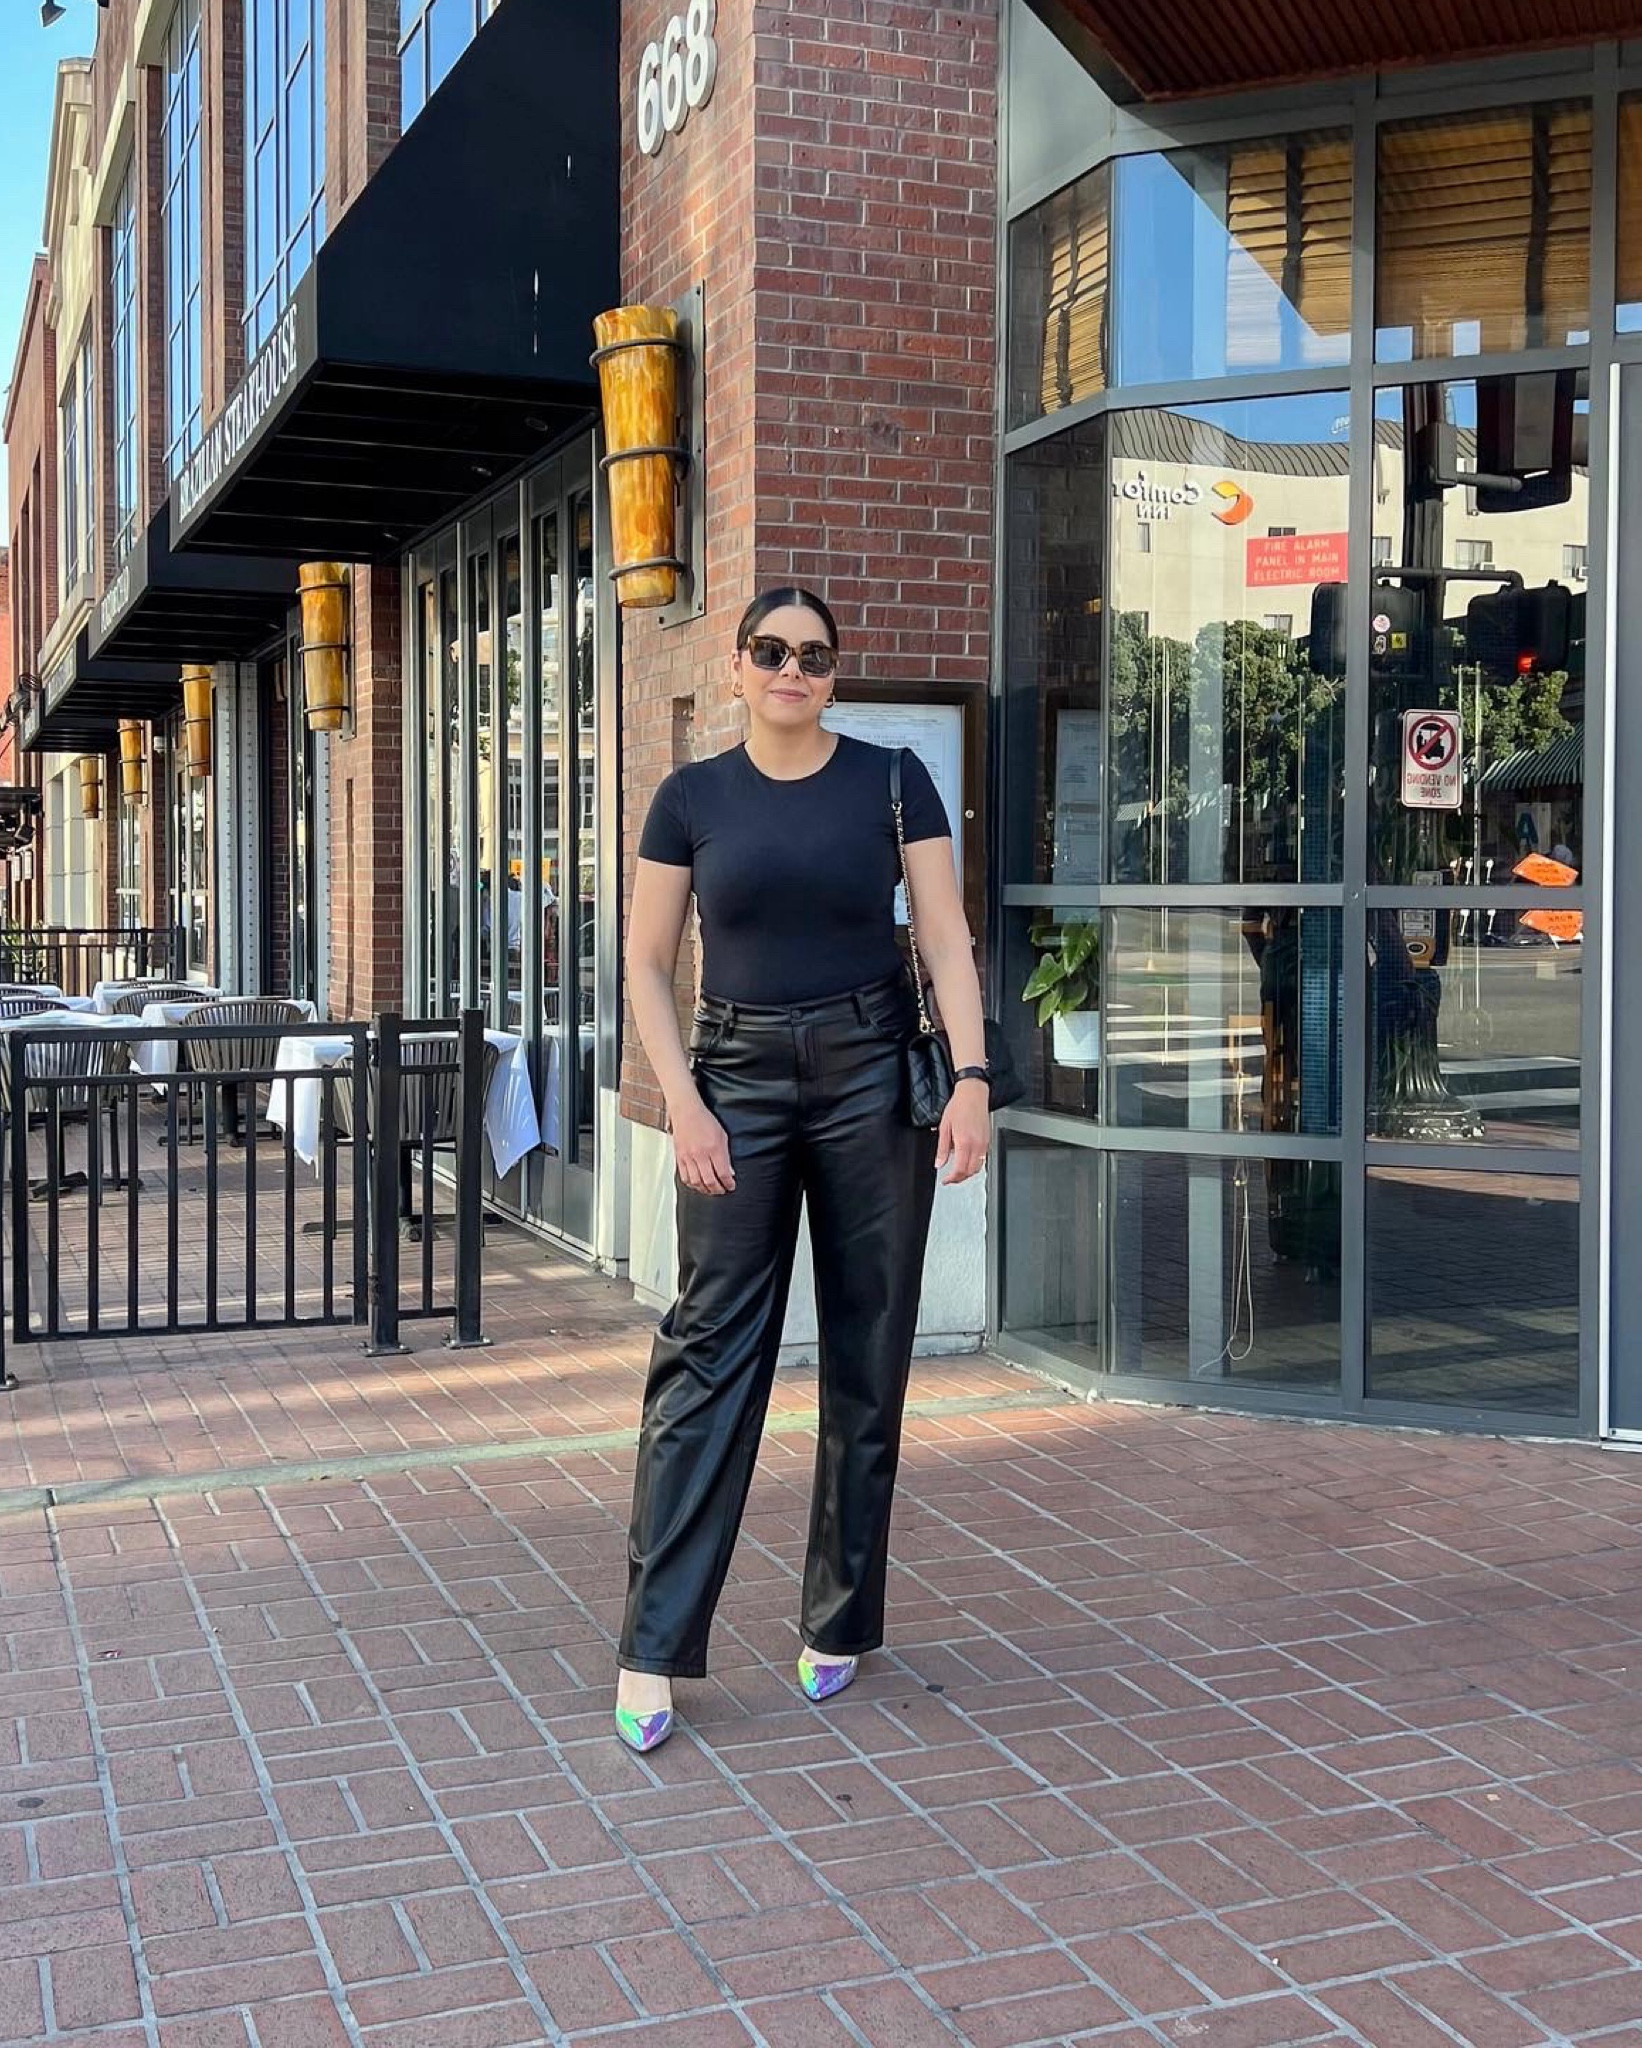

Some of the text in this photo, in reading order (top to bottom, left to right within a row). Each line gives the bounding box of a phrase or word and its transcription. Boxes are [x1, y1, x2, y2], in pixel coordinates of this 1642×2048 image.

[638, 0, 717, 155] 668
[224, 304, 297, 465] STEAKHOUSE
[1264, 539, 1330, 552] FIRE ALARM
[1256, 552, 1339, 567] PANEL IN MAIN
[1253, 567, 1340, 580] ELECTRIC ROOM
